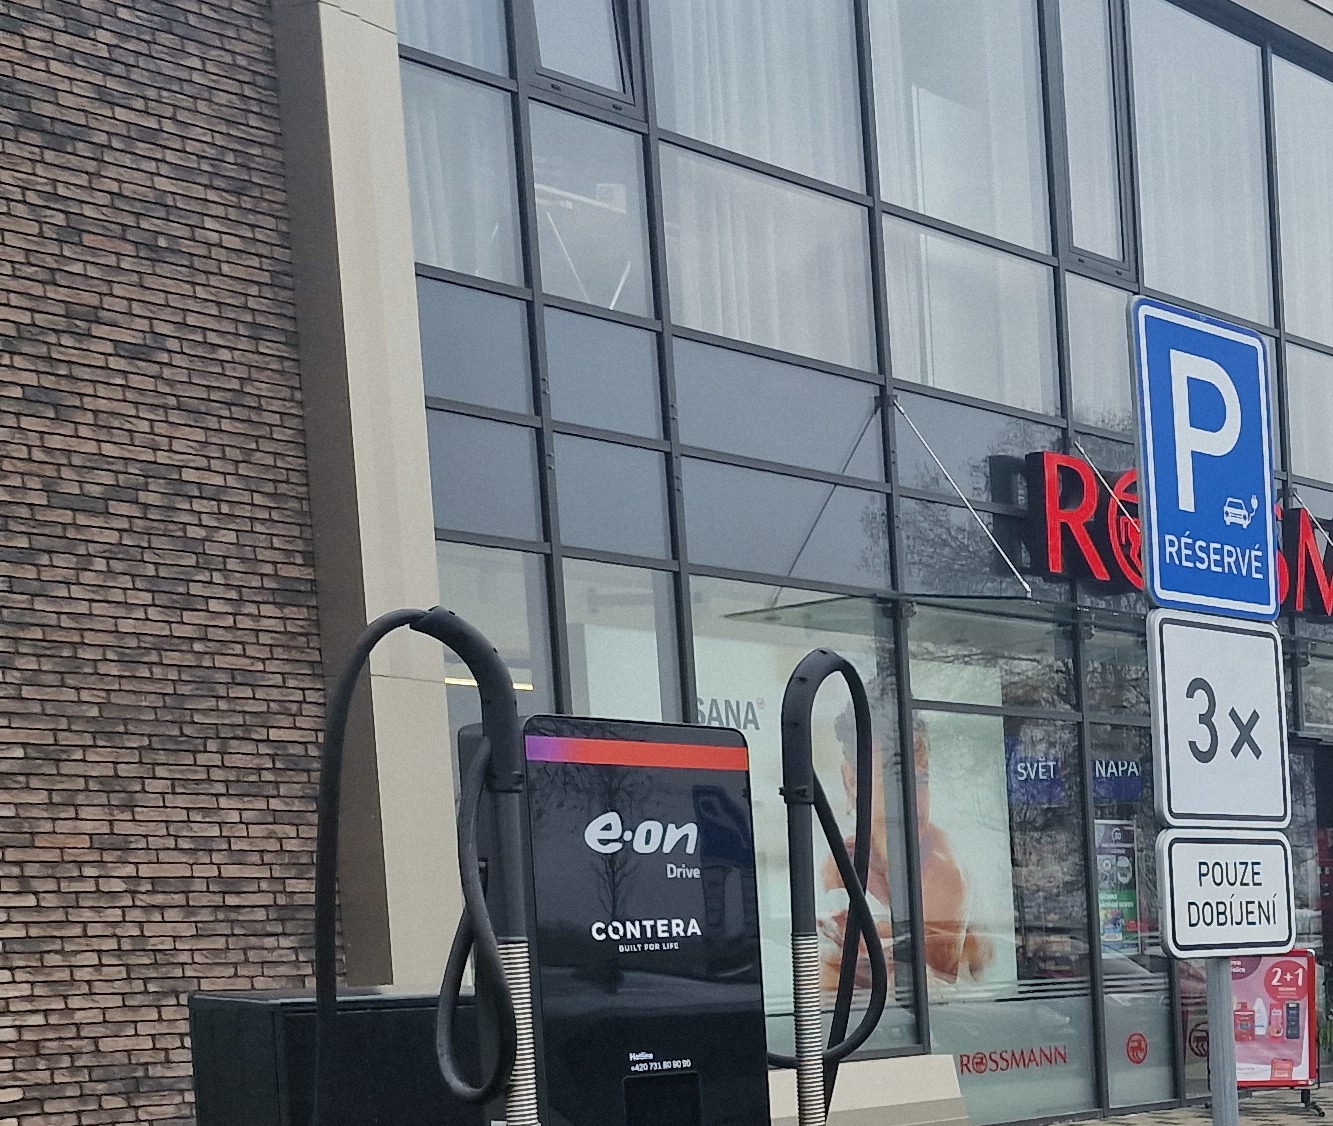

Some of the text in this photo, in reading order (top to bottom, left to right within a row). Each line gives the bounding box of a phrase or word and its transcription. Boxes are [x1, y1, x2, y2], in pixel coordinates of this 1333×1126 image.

[1170, 349, 1241, 512] P
[1164, 531, 1264, 580] RÉSERVÉ
[1016, 757, 1057, 781] SVĚT
[666, 863, 701, 879] Drive
[1198, 861, 1263, 887] POUZE
[1187, 893, 1277, 927] DOBÍJENÍ
[591, 918, 702, 941] CONTERA
[1271, 967, 1303, 987] 2+1
[959, 1044, 1067, 1075] ROSSMANN
